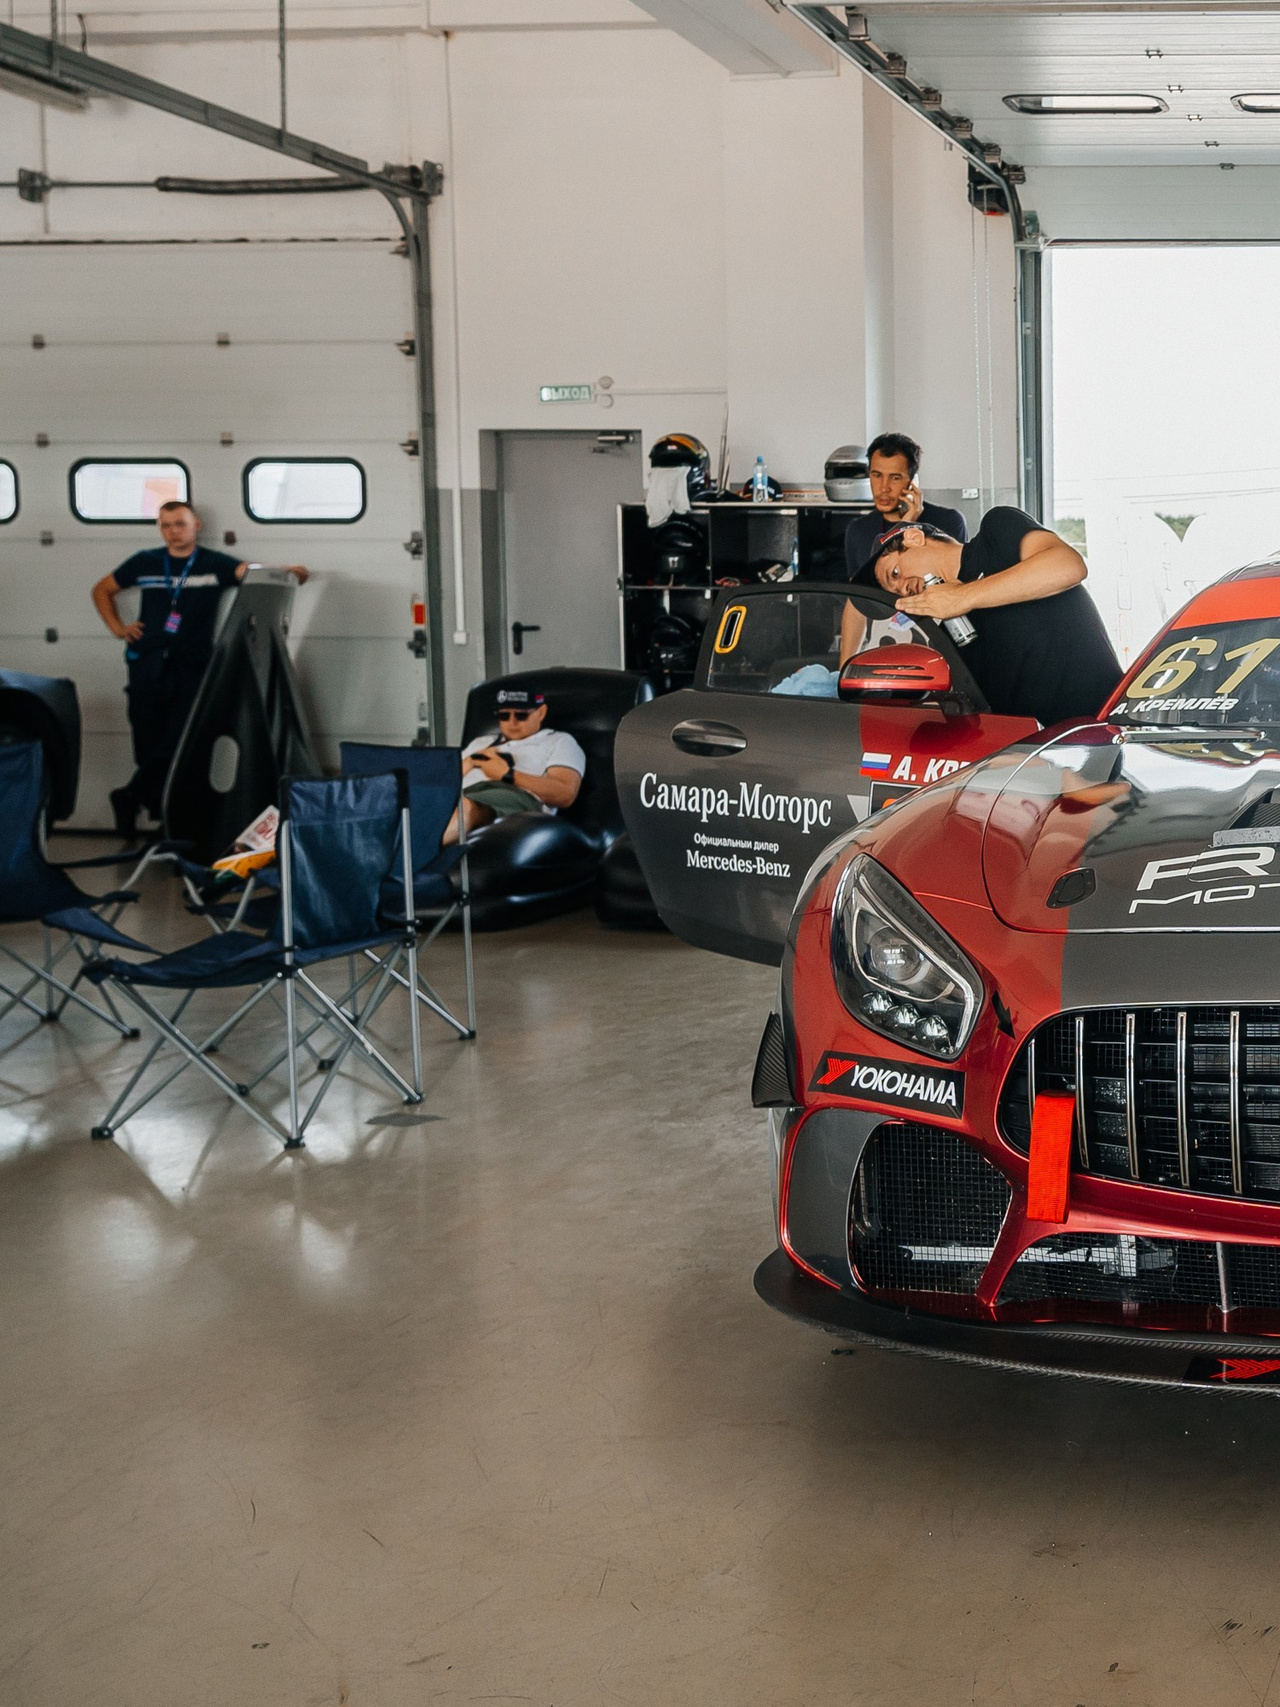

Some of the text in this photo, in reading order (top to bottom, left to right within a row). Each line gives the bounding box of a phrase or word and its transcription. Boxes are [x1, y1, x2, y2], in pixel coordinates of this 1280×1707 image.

[541, 386, 590, 401] ВЫХОД
[1132, 695, 1239, 714] КРЕМЛЁВ
[640, 772, 832, 834] Самара-Моторс
[753, 840, 780, 855] дилер
[686, 850, 791, 878] Mercedes-Benz
[850, 1064, 957, 1107] YOKOHAMA
